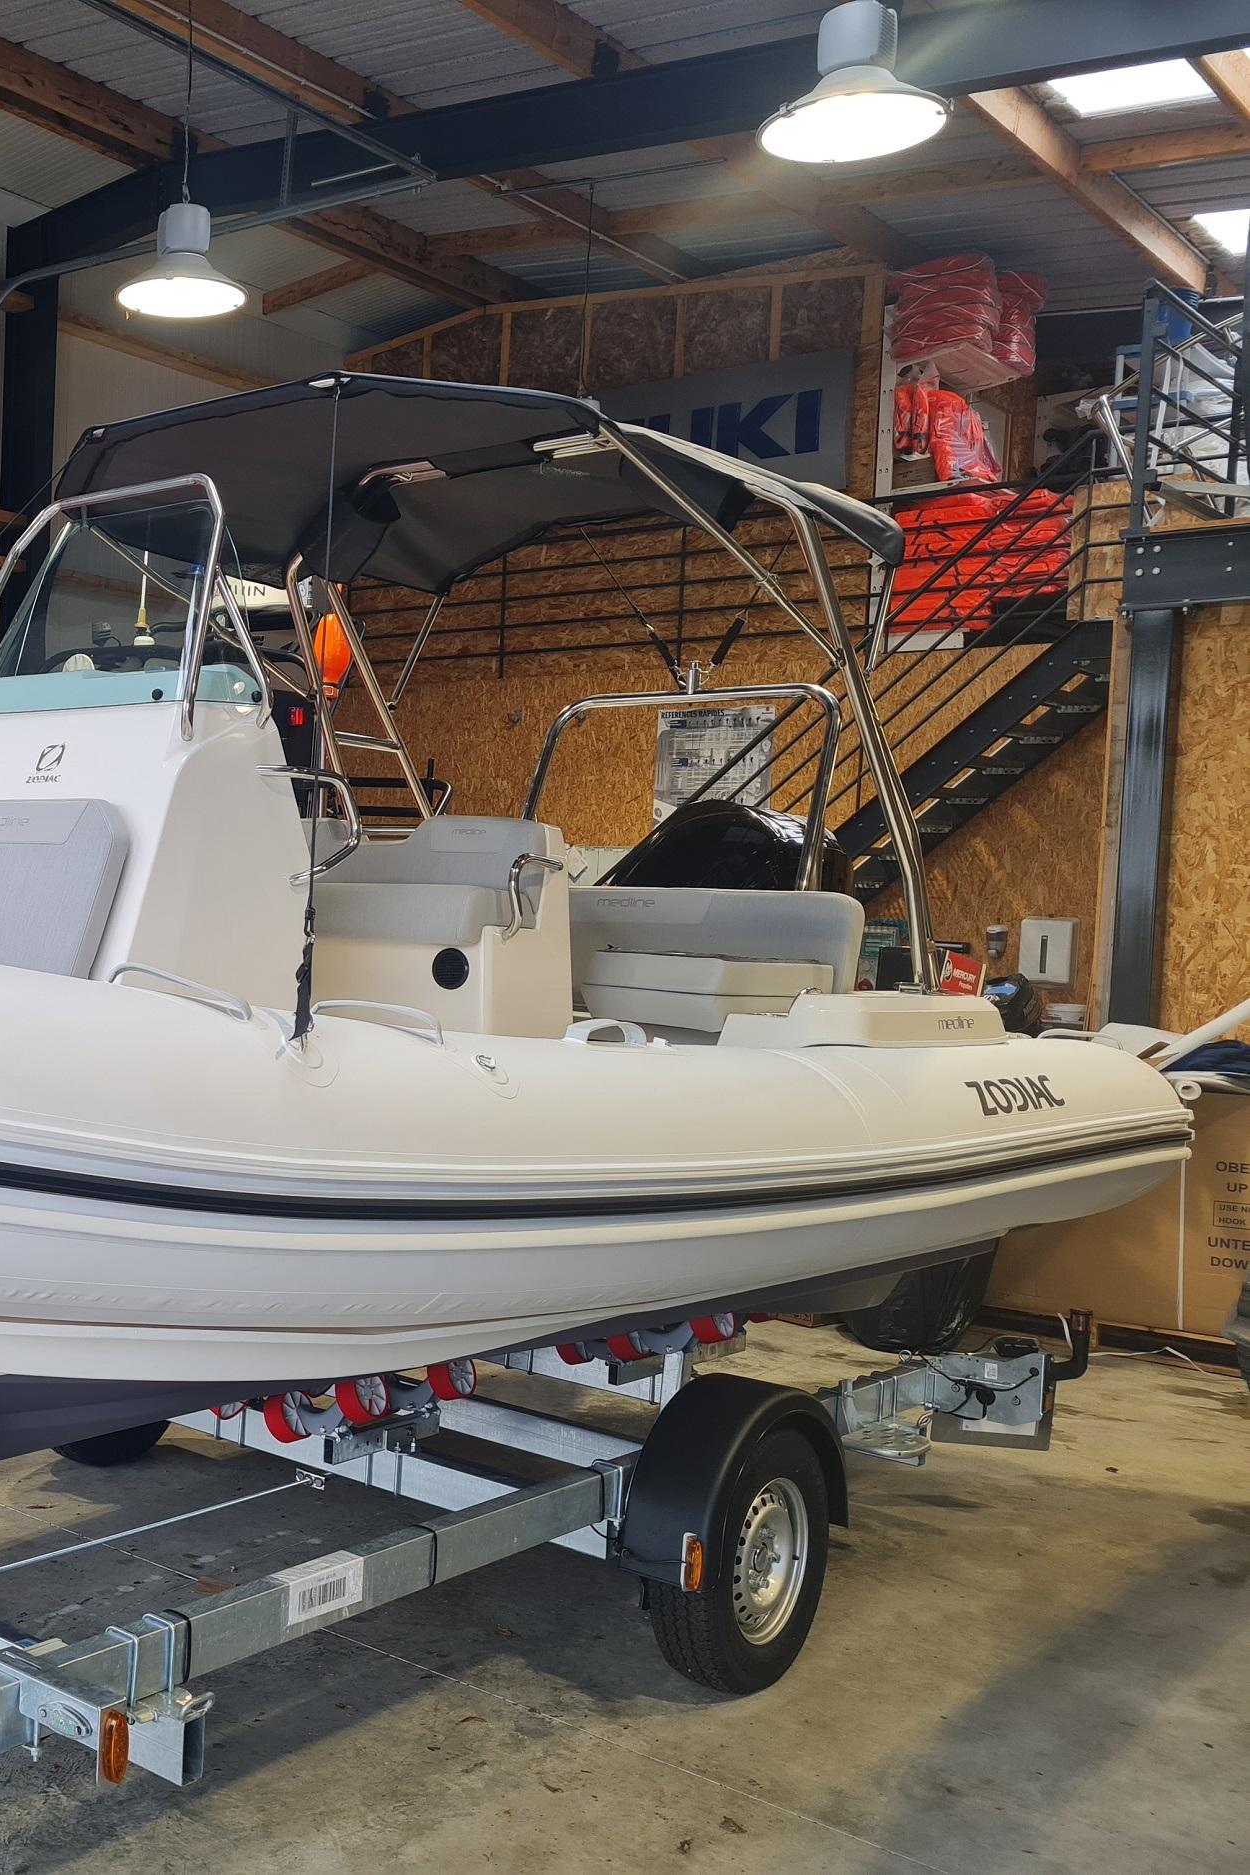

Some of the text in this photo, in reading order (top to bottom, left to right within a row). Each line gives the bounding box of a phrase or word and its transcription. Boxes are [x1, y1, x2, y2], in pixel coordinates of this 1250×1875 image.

[25, 774, 62, 784] ZODIAC
[596, 896, 655, 908] medline
[953, 968, 977, 984] MERCURY
[937, 1015, 975, 1031] medline
[964, 1075, 1066, 1116] ZODIAC
[1215, 1161, 1250, 1174] OBE
[1227, 1182, 1249, 1193] UP
[1208, 1236, 1250, 1252] UNTE
[1210, 1256, 1249, 1270] DOW
